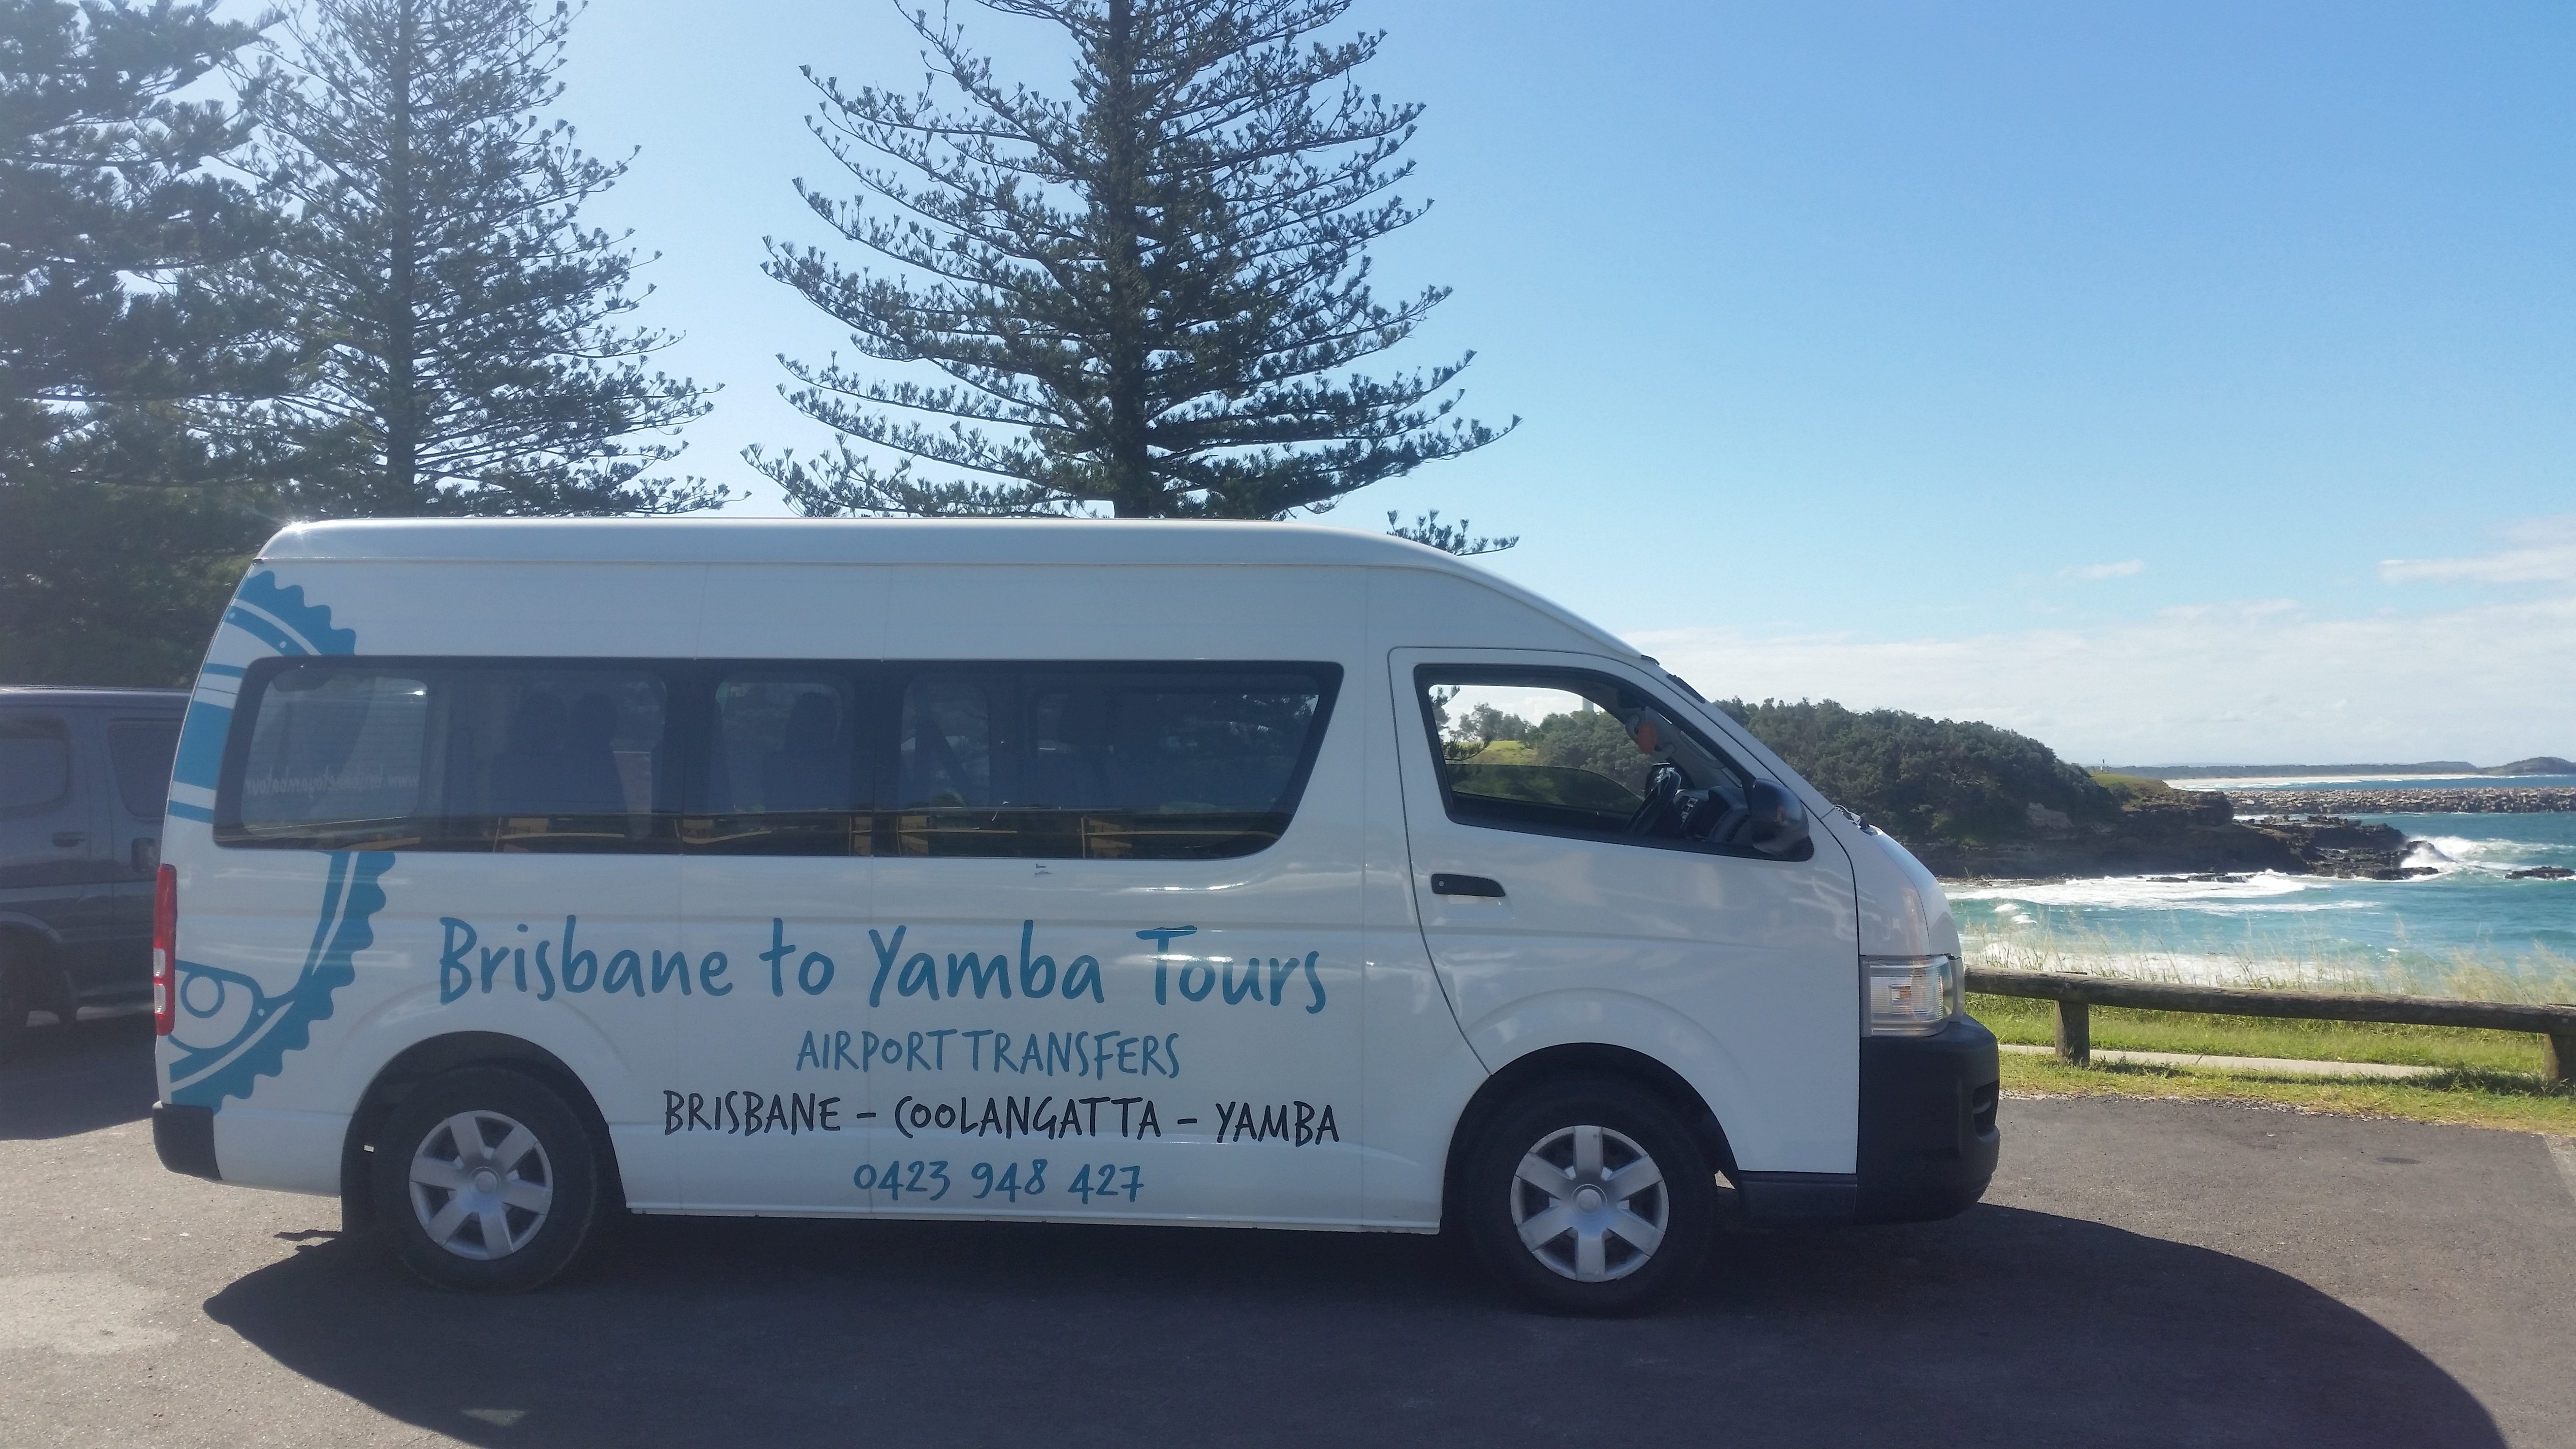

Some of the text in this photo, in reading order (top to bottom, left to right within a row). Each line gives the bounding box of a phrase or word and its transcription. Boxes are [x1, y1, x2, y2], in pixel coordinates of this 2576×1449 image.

[439, 914, 1326, 1014] Brisbane to Yamba Tours
[796, 1029, 1179, 1080] AIRPORT TRANSFERS
[663, 1090, 841, 1137] BRISBANE
[894, 1095, 1161, 1140] COOLANGATTA
[1215, 1100, 1340, 1148] YAMBA
[854, 1159, 1144, 1205] 0423 948 427
